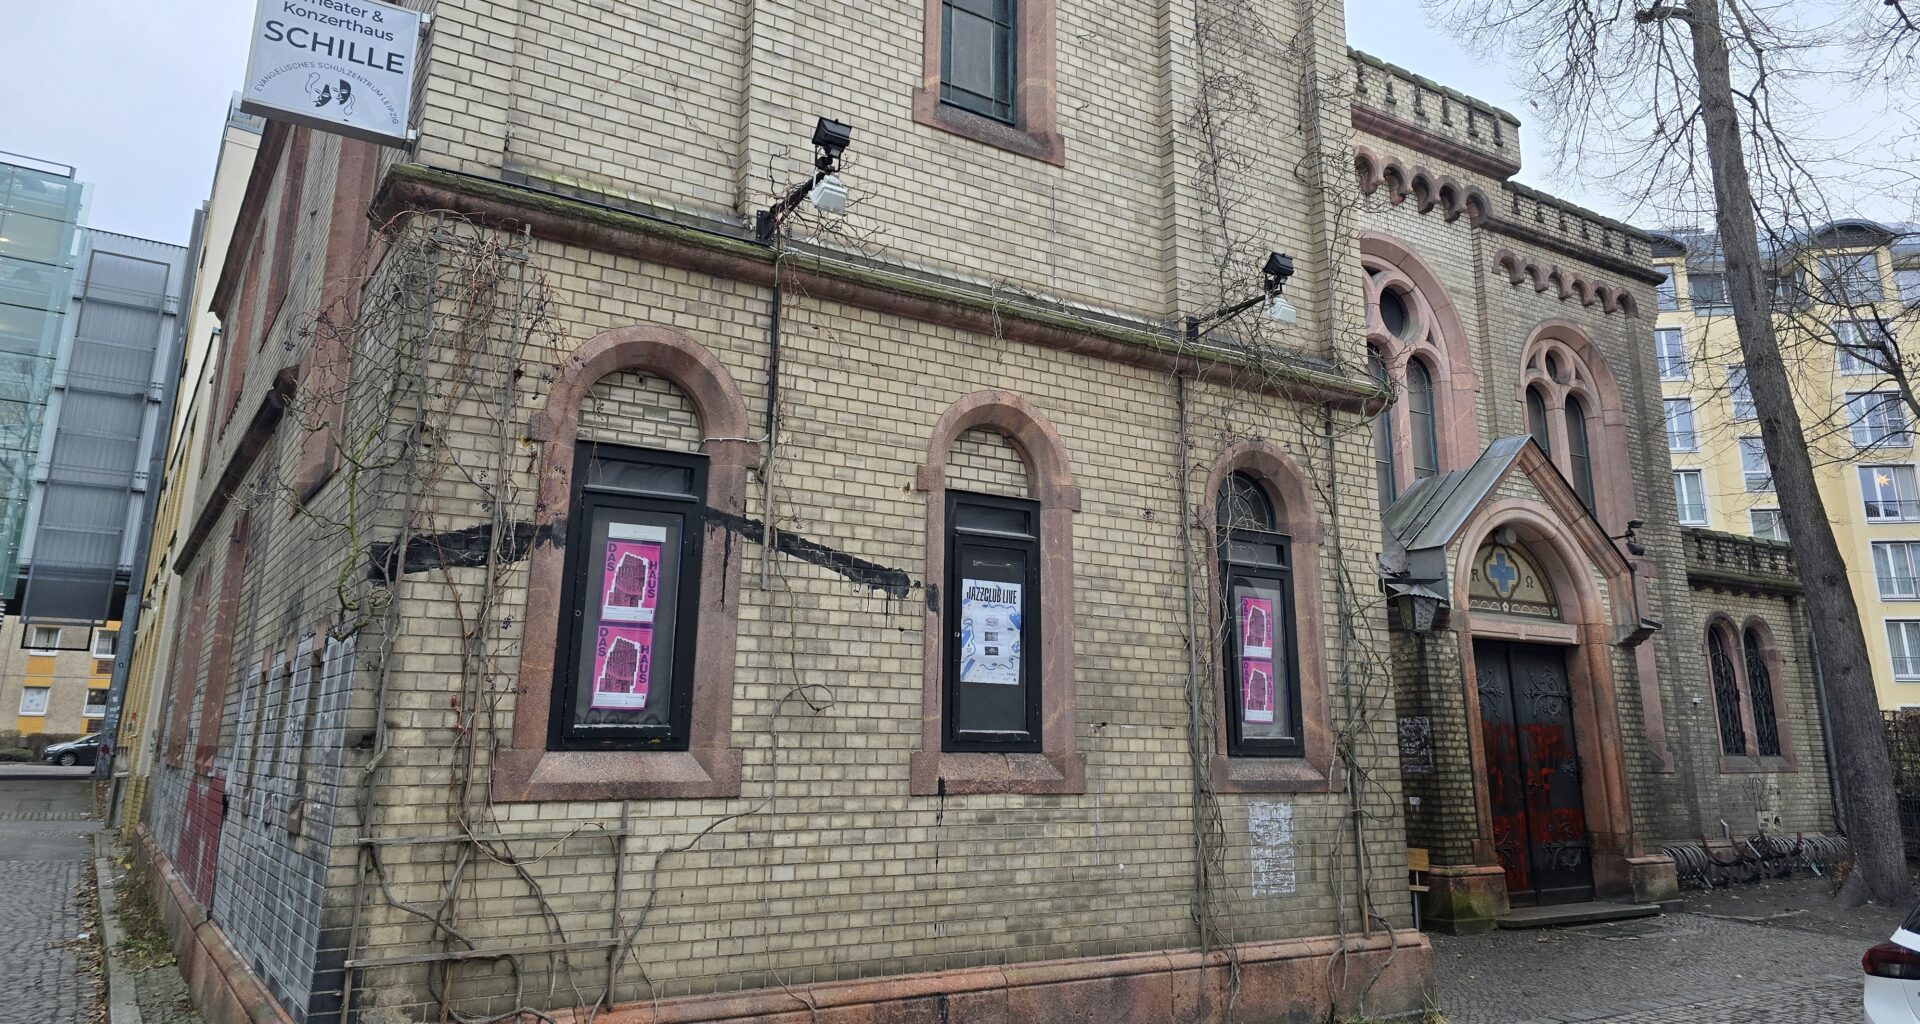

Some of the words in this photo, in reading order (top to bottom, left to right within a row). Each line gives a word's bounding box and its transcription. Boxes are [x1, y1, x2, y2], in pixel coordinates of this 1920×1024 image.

[283, 1, 394, 42] Konzerthaus
[304, 0, 368, 18] eater
[372, 10, 384, 23] &
[263, 20, 405, 75] SCHILLE
[254, 61, 316, 93] EVANGELISCHES
[318, 62, 384, 98] SCHULZENTRUM
[380, 96, 399, 125] LEIPZIG
[606, 543, 618, 572] DAS
[647, 561, 658, 599] HAUS
[966, 586, 1002, 603] JAZZCLUB
[1002, 589, 1018, 605] LIVE
[597, 627, 609, 657] DAS
[639, 644, 650, 684] HAUS
